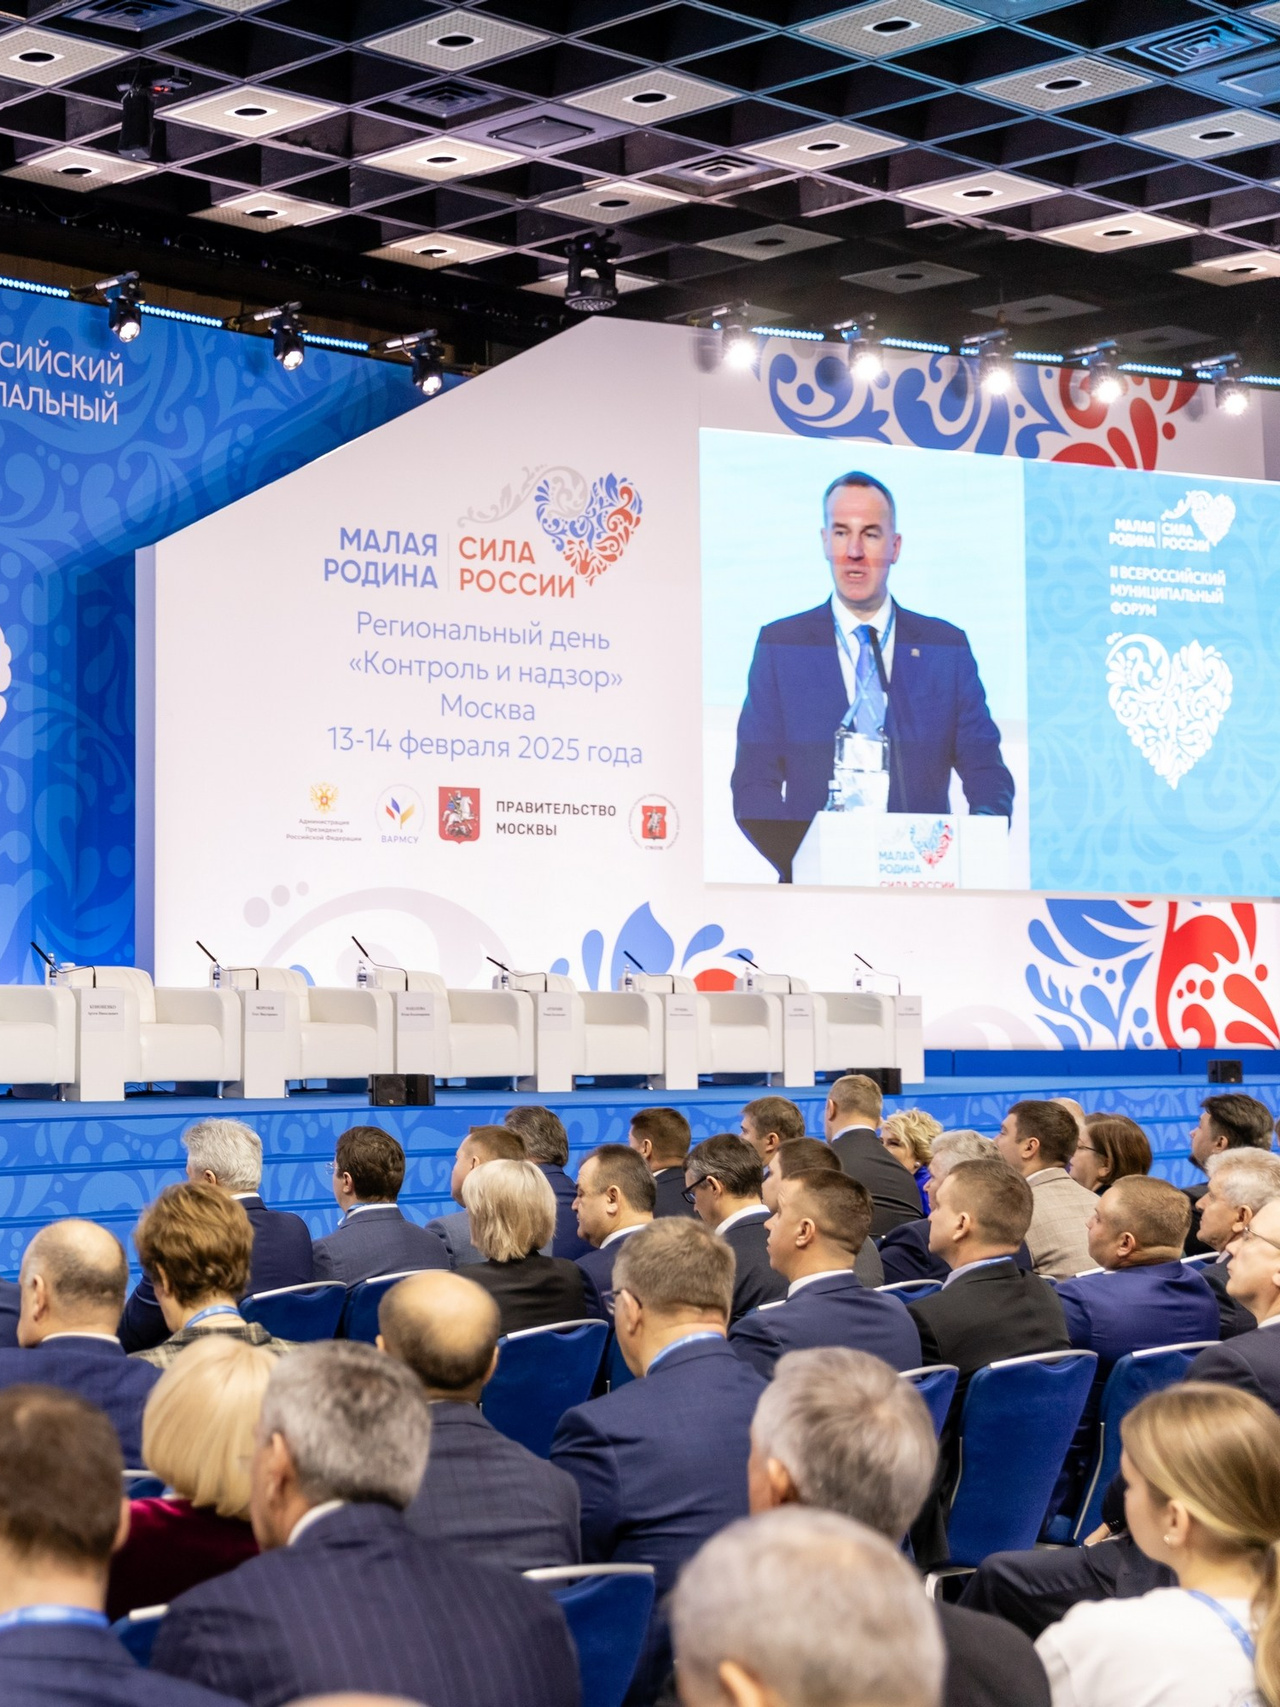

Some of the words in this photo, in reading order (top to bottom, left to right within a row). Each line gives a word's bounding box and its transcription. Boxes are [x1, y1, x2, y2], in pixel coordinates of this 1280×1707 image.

[1115, 519, 1155, 533] МАЛАЯ
[1162, 522, 1194, 537] СИЛА
[339, 527, 438, 557] МАЛАЯ
[1109, 533, 1156, 547] РОДИНА
[1162, 537, 1209, 552] РОССИИ
[458, 536, 536, 564] СИЛА
[324, 558, 438, 589] РОДИНА
[1120, 566, 1226, 585] ВСЕРОССИЙСКИЙ
[459, 568, 575, 598] РОССИИ
[1110, 583, 1224, 604] МУНИЦИПАЛЬНЫЙ
[1111, 602, 1156, 616] ФОРУМ
[356, 611, 543, 646] Региональный
[549, 629, 610, 650] день
[349, 651, 489, 683] «Контроль
[497, 665, 510, 682] и
[519, 667, 623, 693] надзор»
[440, 693, 536, 721] Москва
[327, 726, 392, 753] 13-14
[399, 729, 510, 759] февраля
[518, 735, 580, 761] 2025
[587, 744, 643, 768] года
[495, 800, 617, 818] ПРАВИТЕЛЬСТВО
[495, 822, 557, 837] МОСКВЫ
[381, 835, 419, 844] ВАРМСУ
[879, 851, 915, 860] МАЛАЯ
[879, 864, 921, 873] РОДИНА
